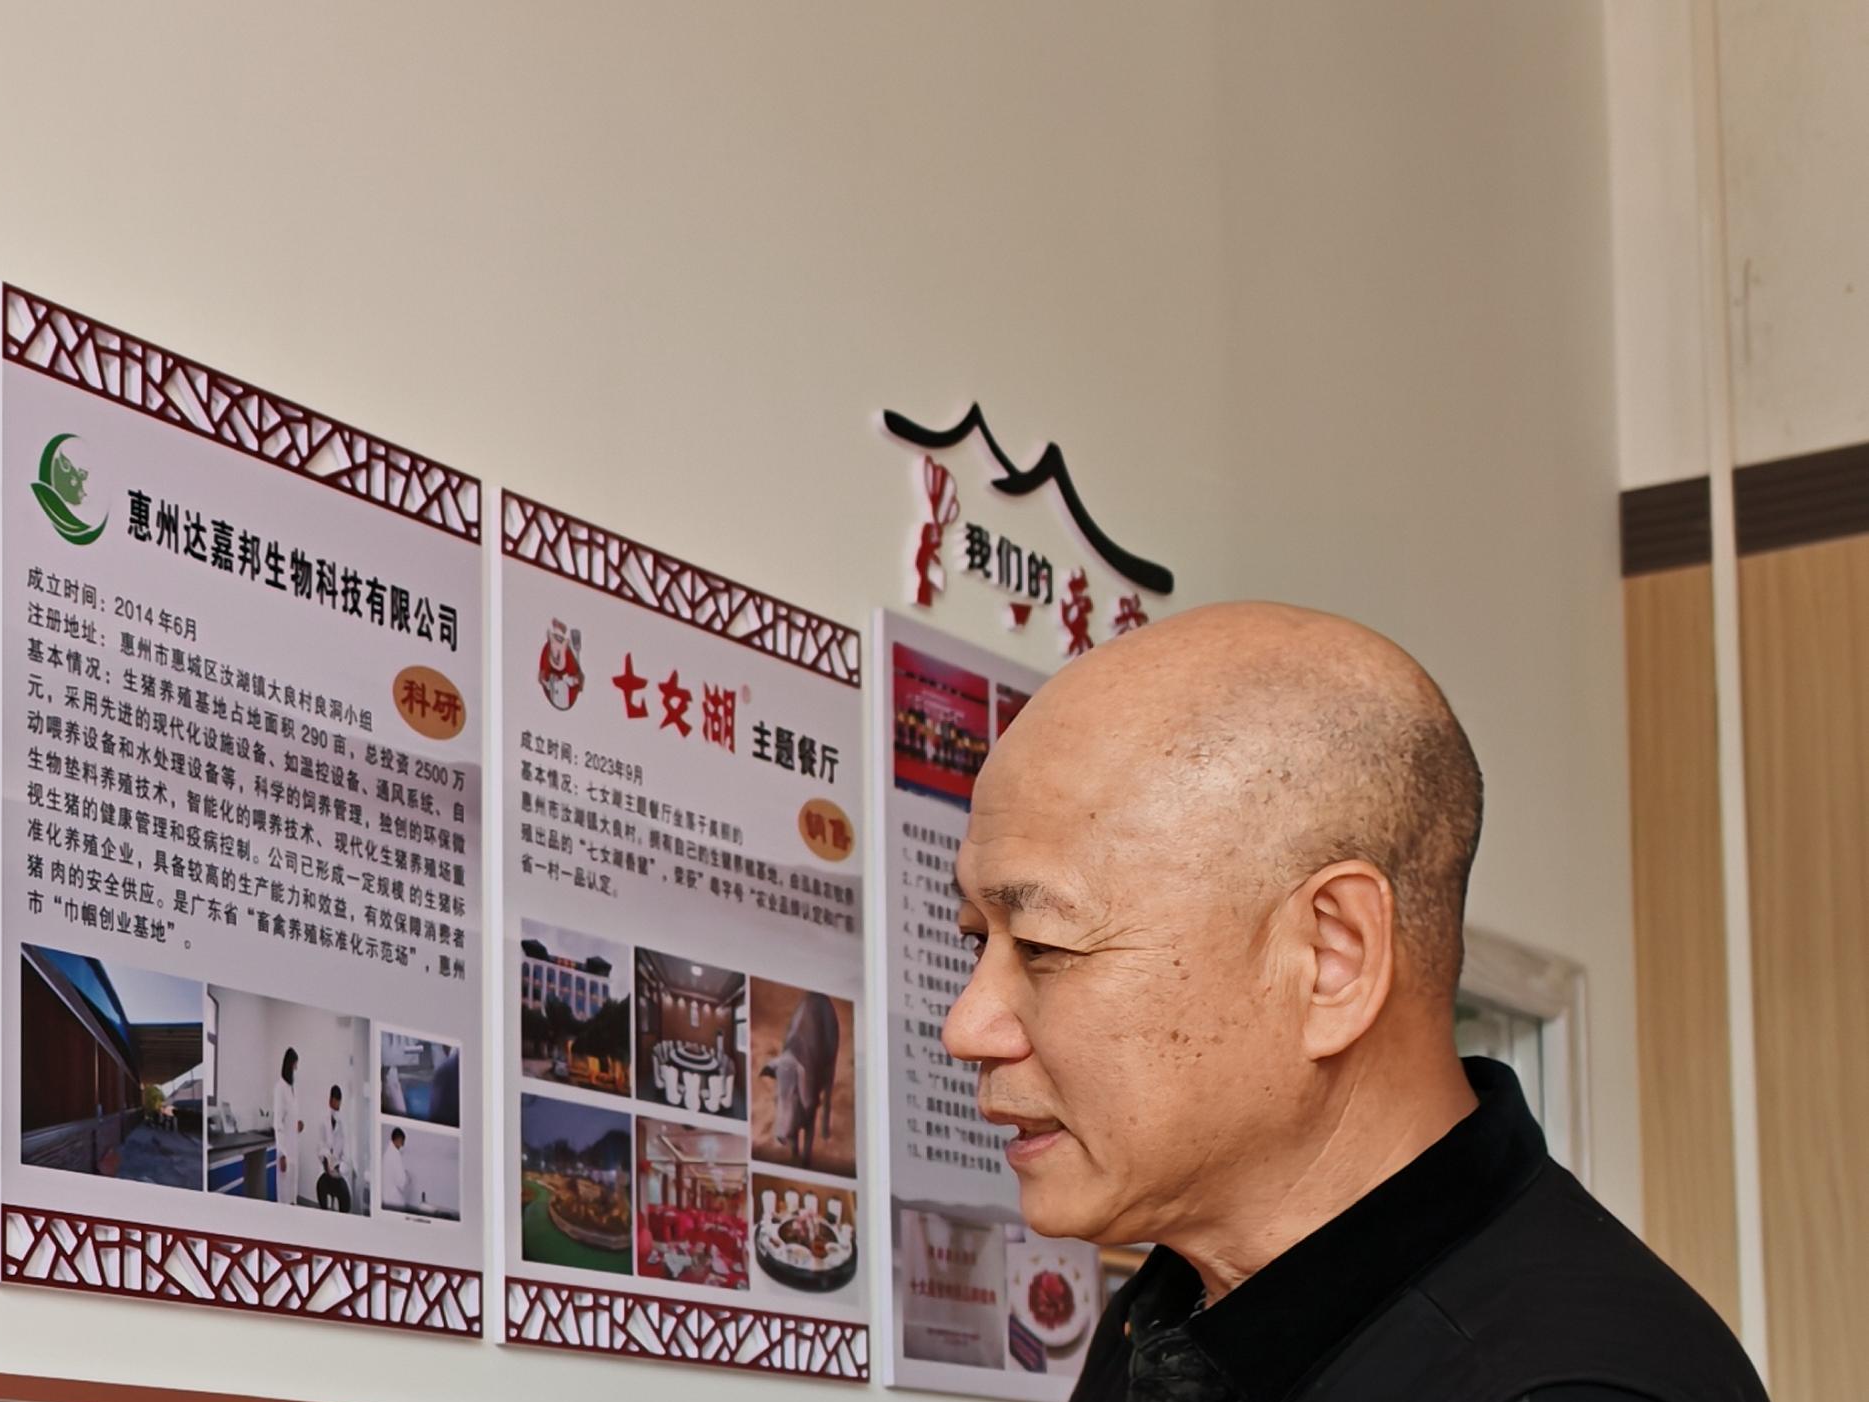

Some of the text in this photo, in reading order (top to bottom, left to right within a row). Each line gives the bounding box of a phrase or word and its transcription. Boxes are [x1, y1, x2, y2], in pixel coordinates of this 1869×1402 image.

[127, 489, 458, 651] 惠州达嘉邦生物科技有限公司
[401, 678, 462, 727] 科研
[612, 652, 839, 784] 七女湖 主题餐厅
